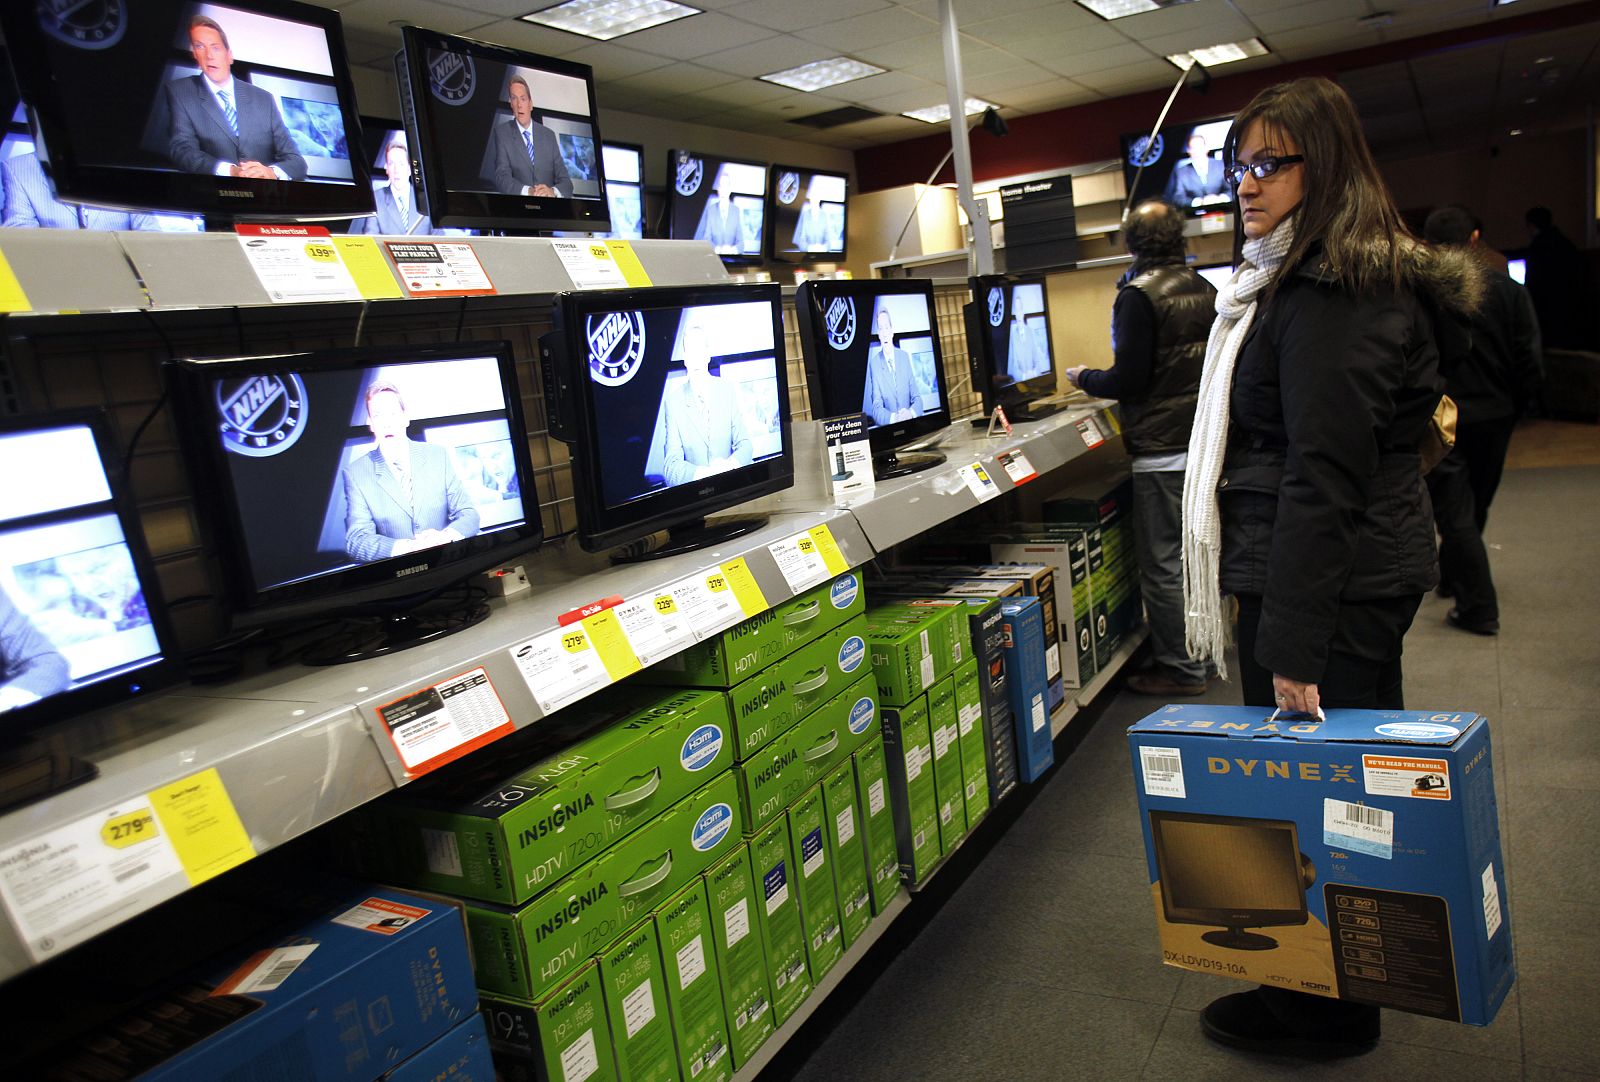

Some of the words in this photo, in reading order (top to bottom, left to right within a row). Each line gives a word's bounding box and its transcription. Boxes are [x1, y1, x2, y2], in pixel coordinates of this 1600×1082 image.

[436, 53, 464, 79] NHL
[217, 190, 254, 199] SAMSUNG
[1002, 188, 1023, 198] home
[1024, 183, 1053, 193] theater
[596, 313, 628, 358] NHL
[233, 376, 278, 426] NHL
[825, 424, 844, 433] Safely
[845, 421, 862, 429] clean
[826, 433, 840, 441] your
[842, 429, 862, 437] screen
[395, 564, 429, 577] SAMSUNG
[589, 605, 602, 614] Sale
[982, 612, 1002, 630] INSIGNIA
[730, 610, 777, 641] INSIGNIA
[735, 651, 759, 674] HDTV
[622, 692, 701, 730] INSIGNIA
[741, 680, 787, 718] INSIGNIA
[745, 724, 768, 750] HDTV
[1155, 719, 1320, 733] DYNEX
[689, 731, 713, 750] HDMI
[540, 754, 589, 781] HDTV
[754, 748, 799, 789] INSIGNIA
[1208, 757, 1356, 783] DYNEX
[1464, 746, 1487, 774] DYNEX
[758, 793, 780, 819] HDTV
[519, 792, 595, 849] INSIGNIA
[700, 811, 724, 830] HDMI
[525, 853, 564, 889] HDTV
[569, 831, 604, 858] 720p
[608, 814, 622, 834] 19
[757, 827, 782, 850] INSIGNIA
[485, 831, 503, 890] INSIGNIA
[714, 859, 743, 884] INSIGNIA
[535, 881, 609, 944] INSIGNIA
[666, 893, 699, 923] INSIGNIA
[1355, 917, 1376, 927] 720p
[542, 942, 577, 982] HDTV
[584, 919, 617, 949] 720p
[621, 900, 635, 921] 19
[611, 933, 648, 967] INSIGNIA
[501, 927, 518, 983] INSIGNIA
[428, 947, 451, 1009] DYNEX
[1300, 981, 1331, 993] HDMI
[548, 980, 590, 1018] INSIGNIA
